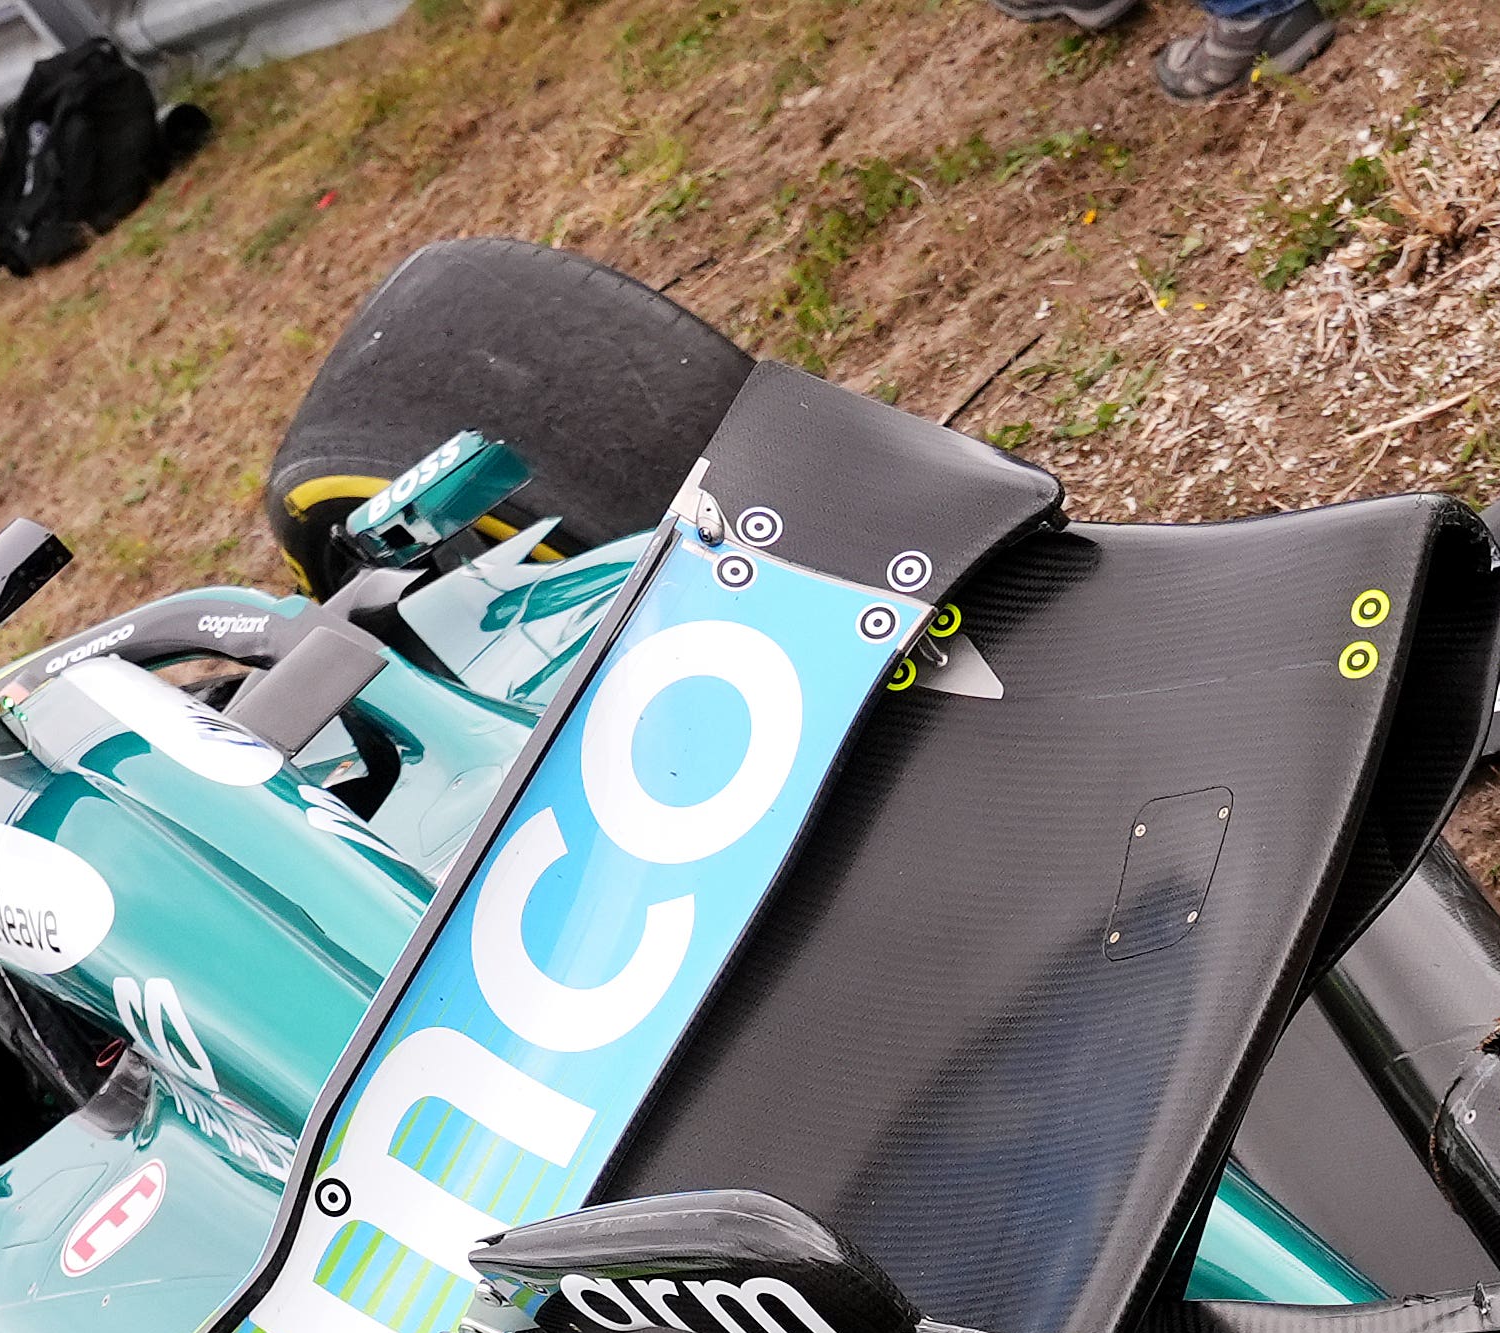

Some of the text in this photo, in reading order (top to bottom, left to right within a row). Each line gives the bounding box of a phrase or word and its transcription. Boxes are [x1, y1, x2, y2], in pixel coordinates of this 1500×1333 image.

[368, 434, 461, 524] BOSS
[45, 623, 135, 674] aramco
[198, 612, 270, 639] cognizant
